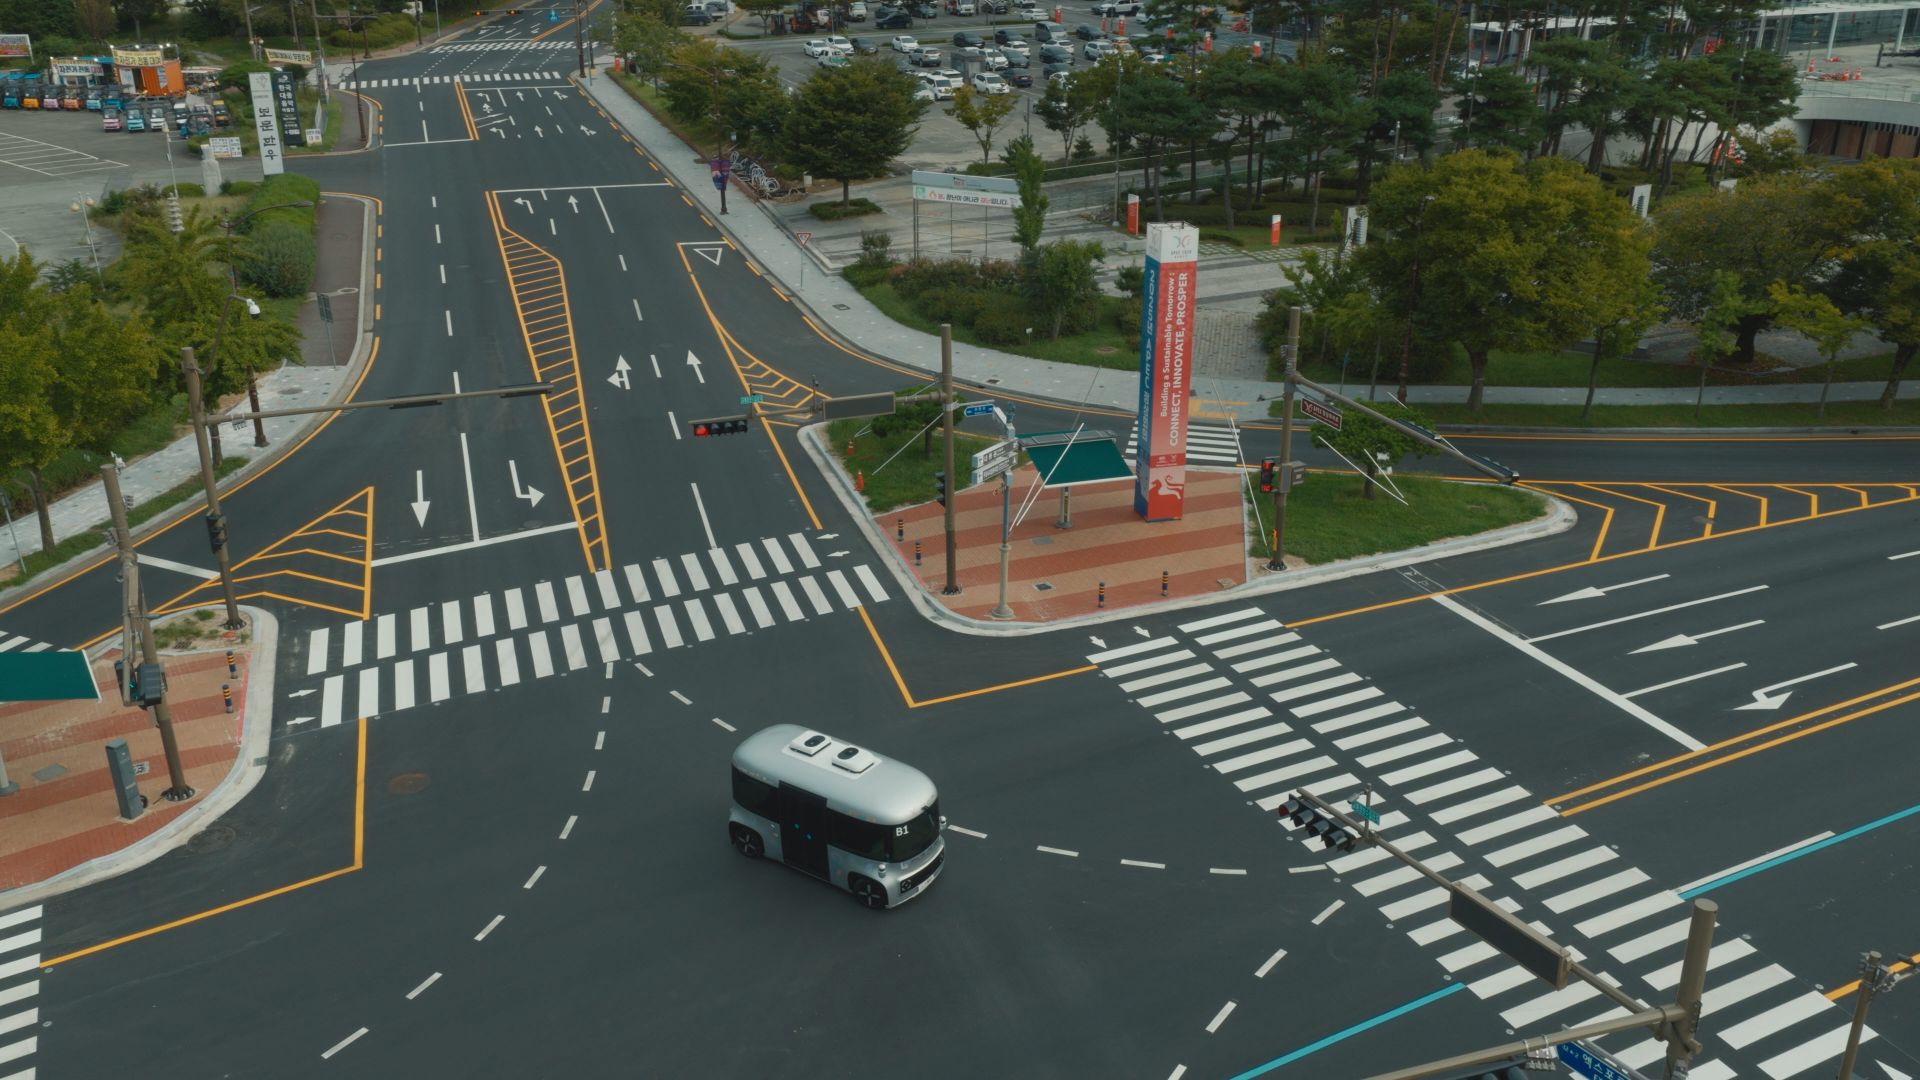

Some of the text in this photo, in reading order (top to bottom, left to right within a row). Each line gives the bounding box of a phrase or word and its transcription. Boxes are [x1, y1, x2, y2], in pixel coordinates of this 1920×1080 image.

[1165, 277, 1175, 323] Tomorrow
[1176, 272, 1188, 325] PROSPER
[1144, 337, 1152, 389] APEC
[1163, 323, 1172, 374] Sustainable
[1173, 327, 1186, 389] INNOVATE,
[1160, 382, 1171, 417] Building
[1169, 390, 1183, 446] CONNECT,
[896, 825, 909, 837] B1
